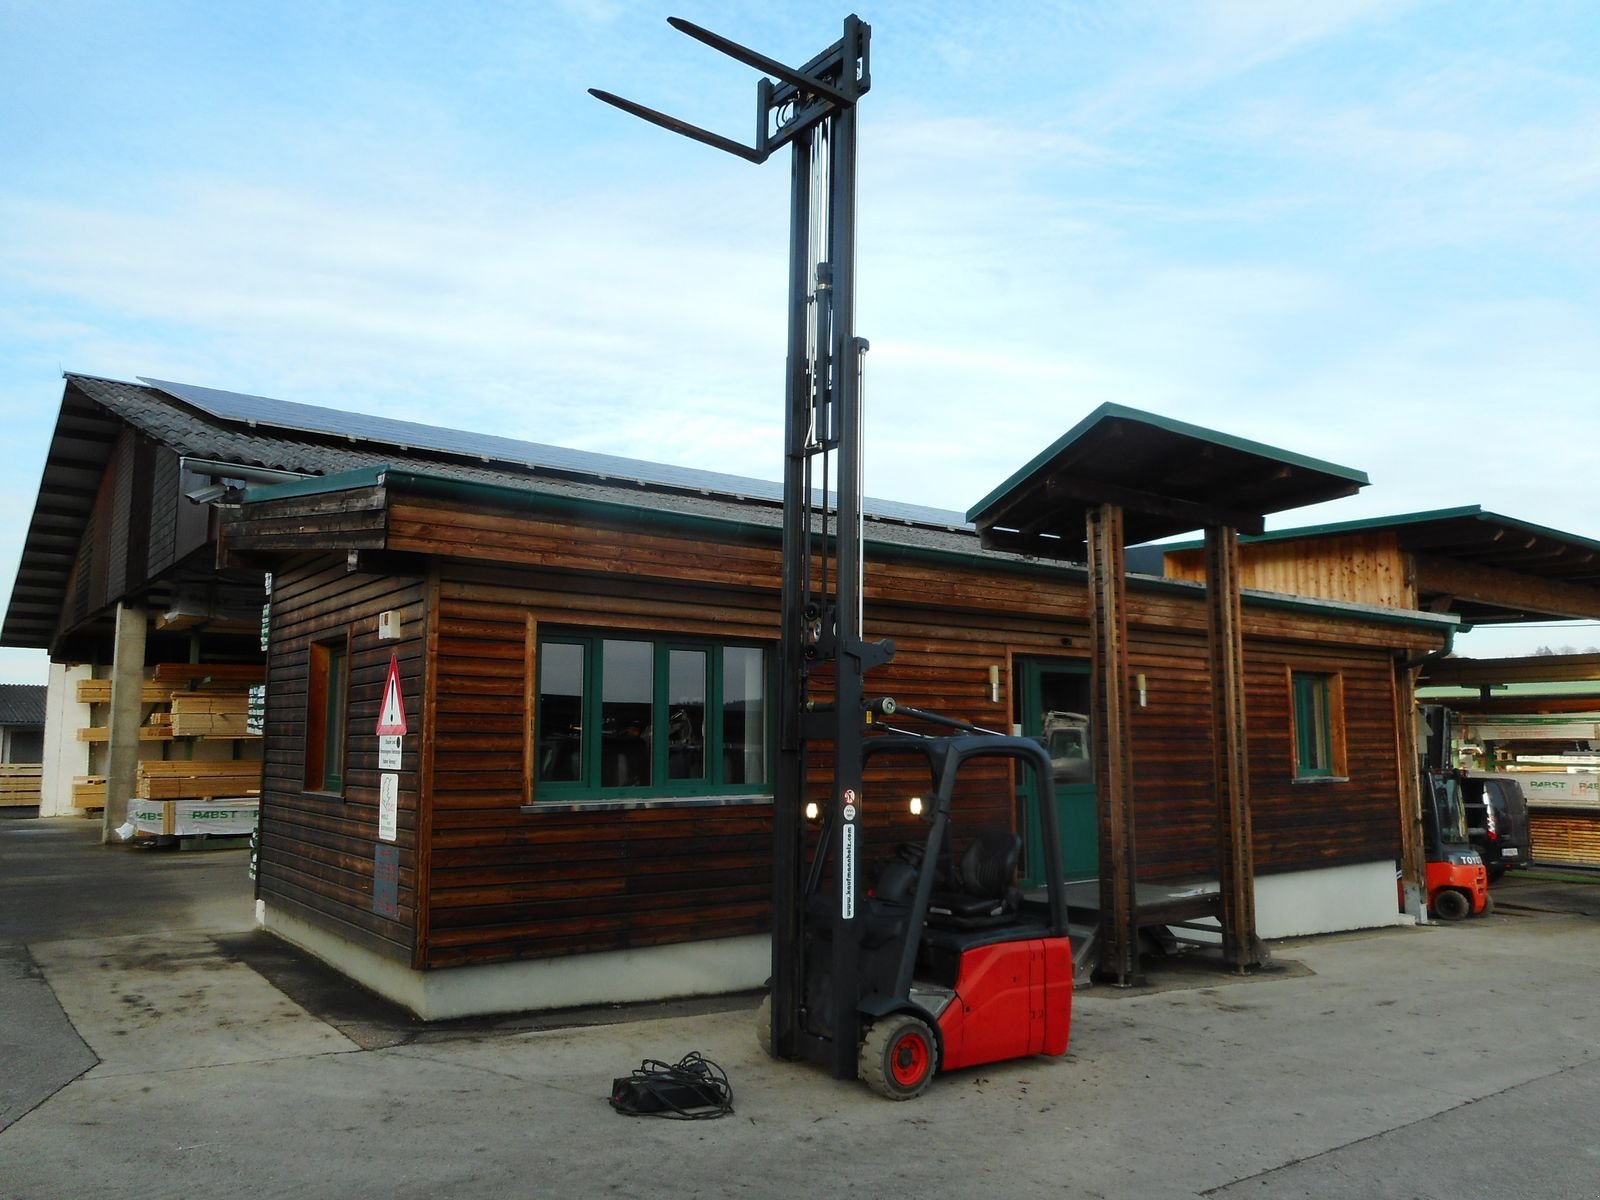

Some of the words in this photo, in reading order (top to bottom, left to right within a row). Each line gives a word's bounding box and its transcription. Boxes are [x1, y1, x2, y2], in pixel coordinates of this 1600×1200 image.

[1530, 781, 1566, 789] PABST
[1579, 782, 1600, 790] PAB
[192, 810, 238, 819] PABST
